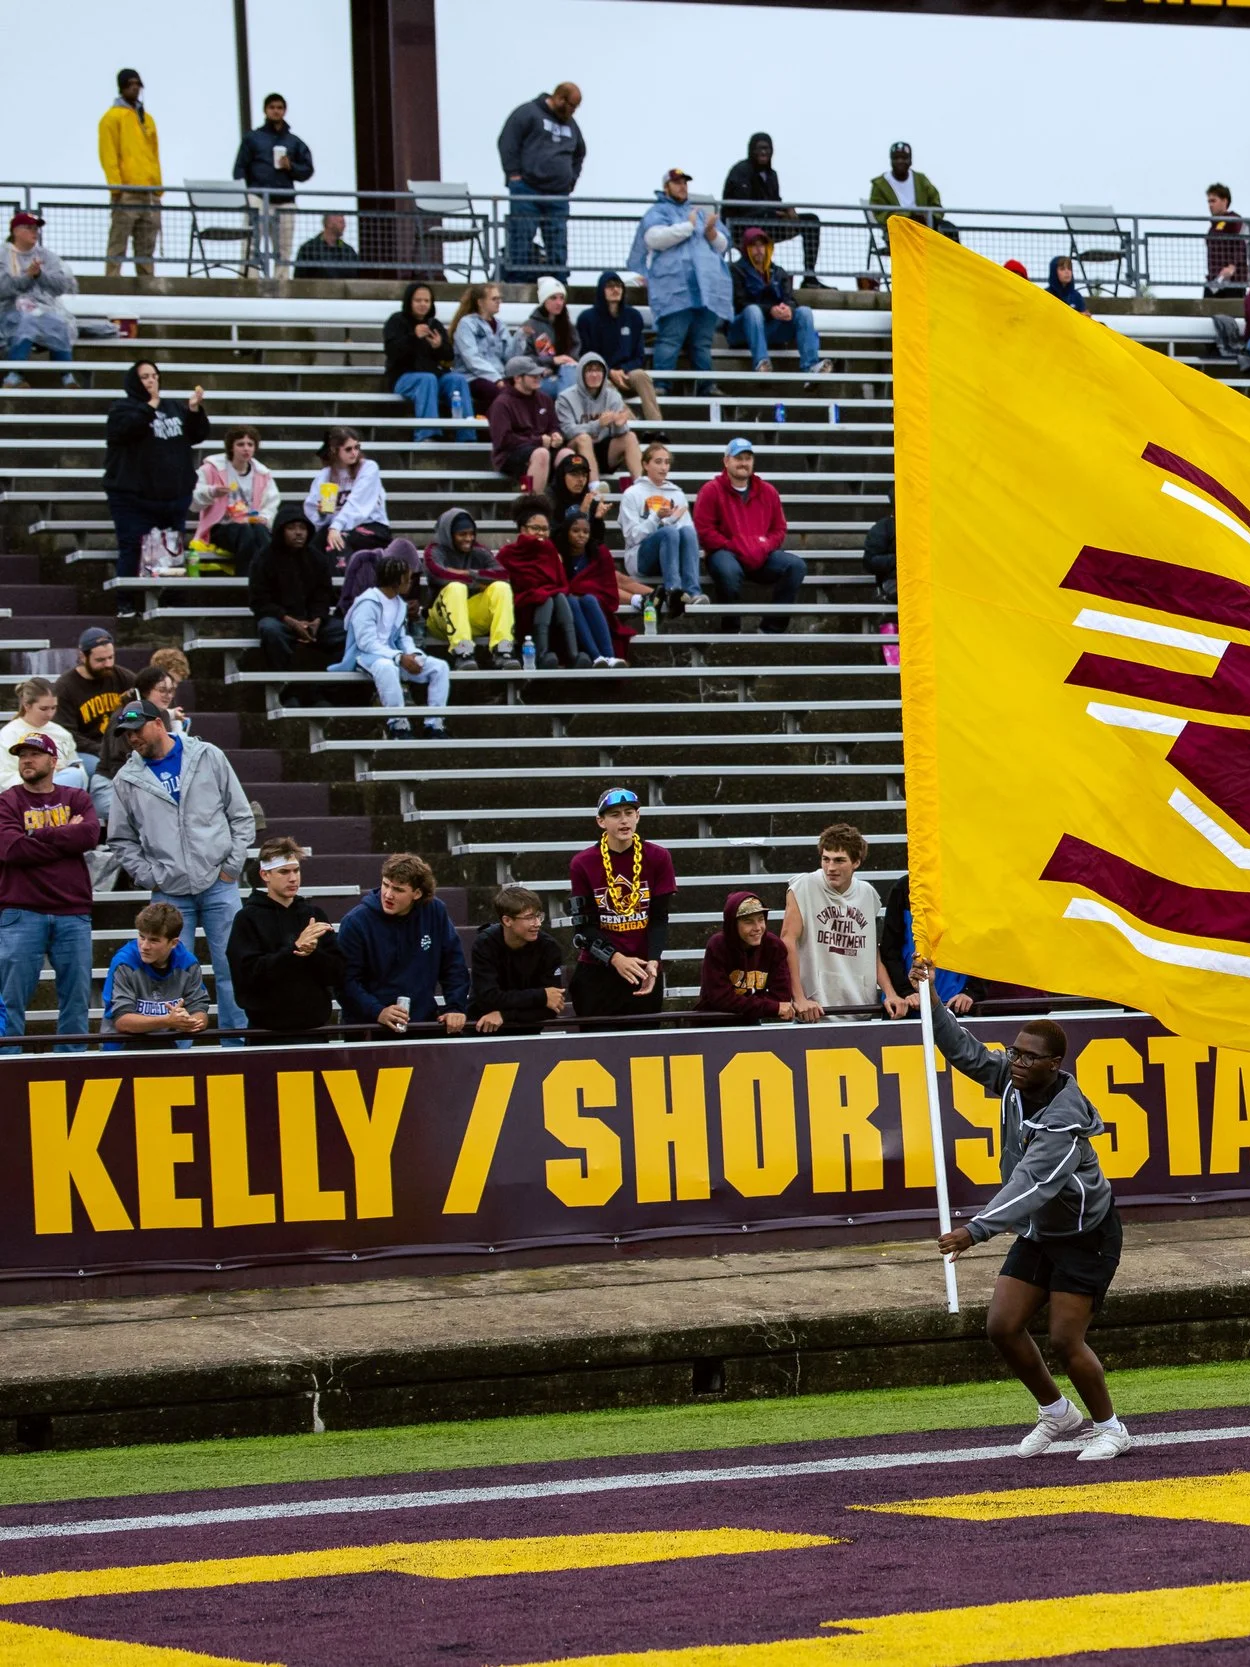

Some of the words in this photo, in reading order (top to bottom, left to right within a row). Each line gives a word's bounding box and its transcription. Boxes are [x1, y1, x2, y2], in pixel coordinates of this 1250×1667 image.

[600, 911, 648, 923] CENTRAL
[831, 919, 855, 933] ATHL
[817, 930, 866, 949] DEPARTMENT
[28, 1066, 414, 1235] KELLY
